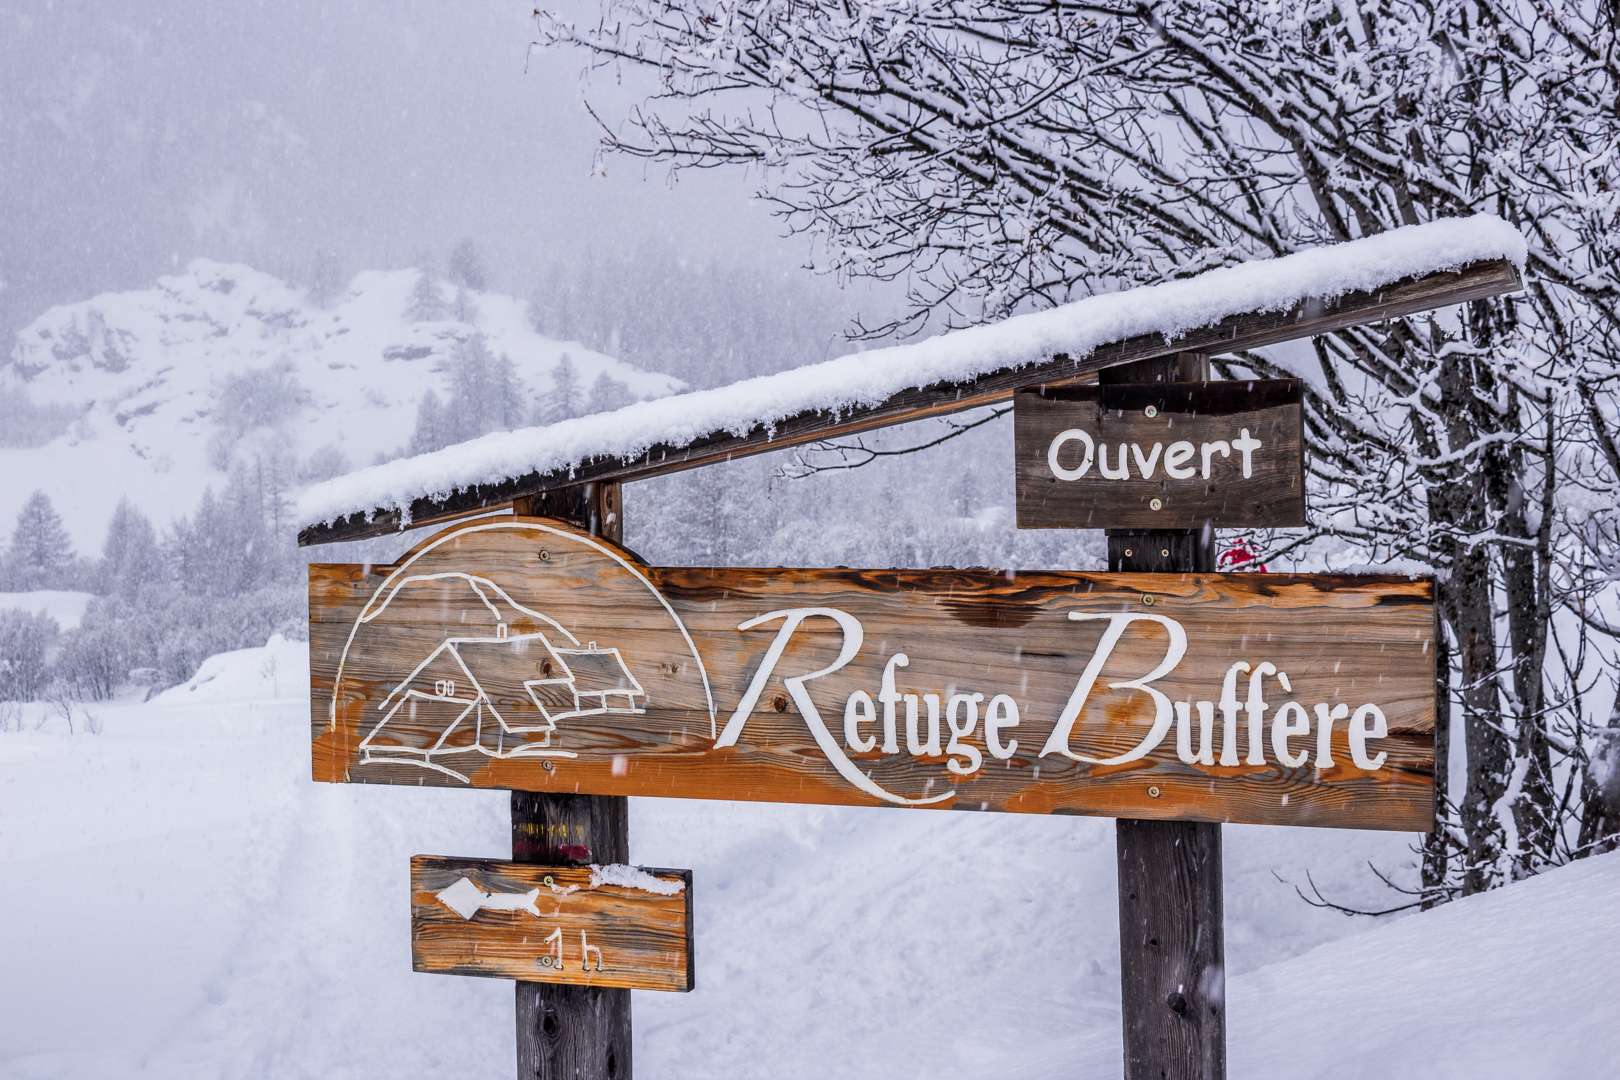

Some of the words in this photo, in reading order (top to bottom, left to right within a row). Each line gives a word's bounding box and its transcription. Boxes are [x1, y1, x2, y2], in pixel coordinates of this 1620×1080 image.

[1048, 428, 1262, 481] Ouvert
[713, 607, 1020, 805] Refuge
[1038, 611, 1388, 771] Buffère
